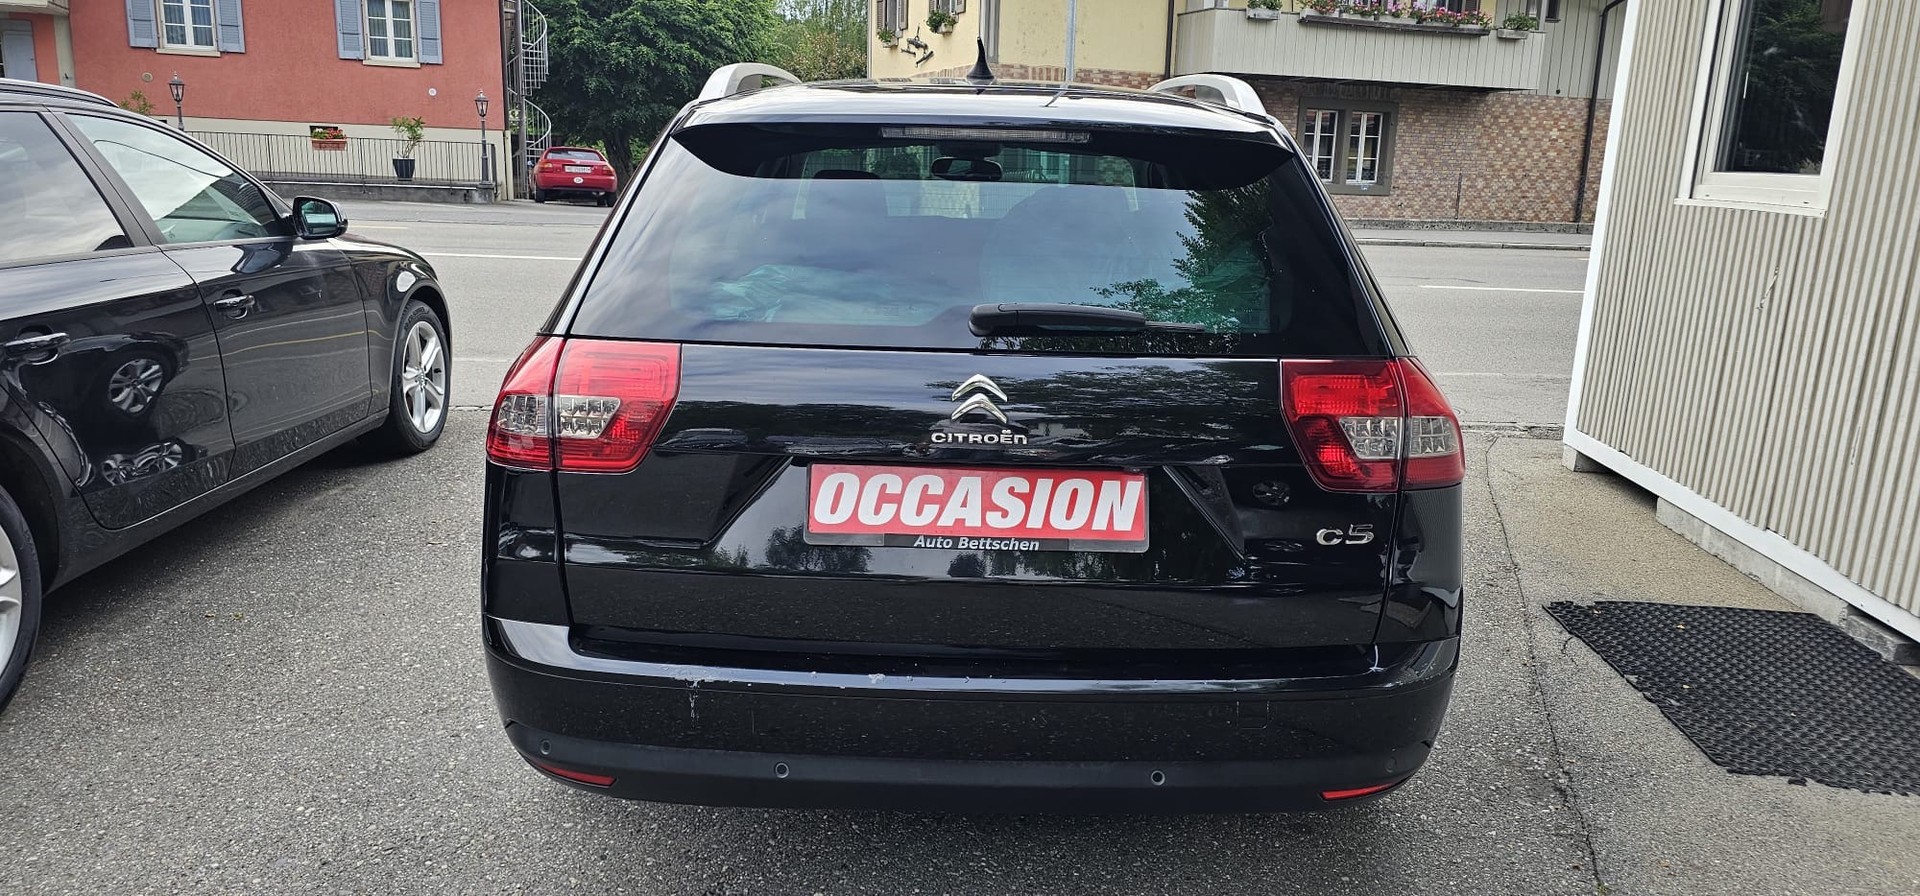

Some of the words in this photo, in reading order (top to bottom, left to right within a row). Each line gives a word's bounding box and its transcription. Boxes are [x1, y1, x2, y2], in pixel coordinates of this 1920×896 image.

[813, 472, 1143, 532] OCCASION
[913, 535, 953, 549] Auto
[957, 536, 1040, 551] Bettschen
[1316, 523, 1375, 546] C5
